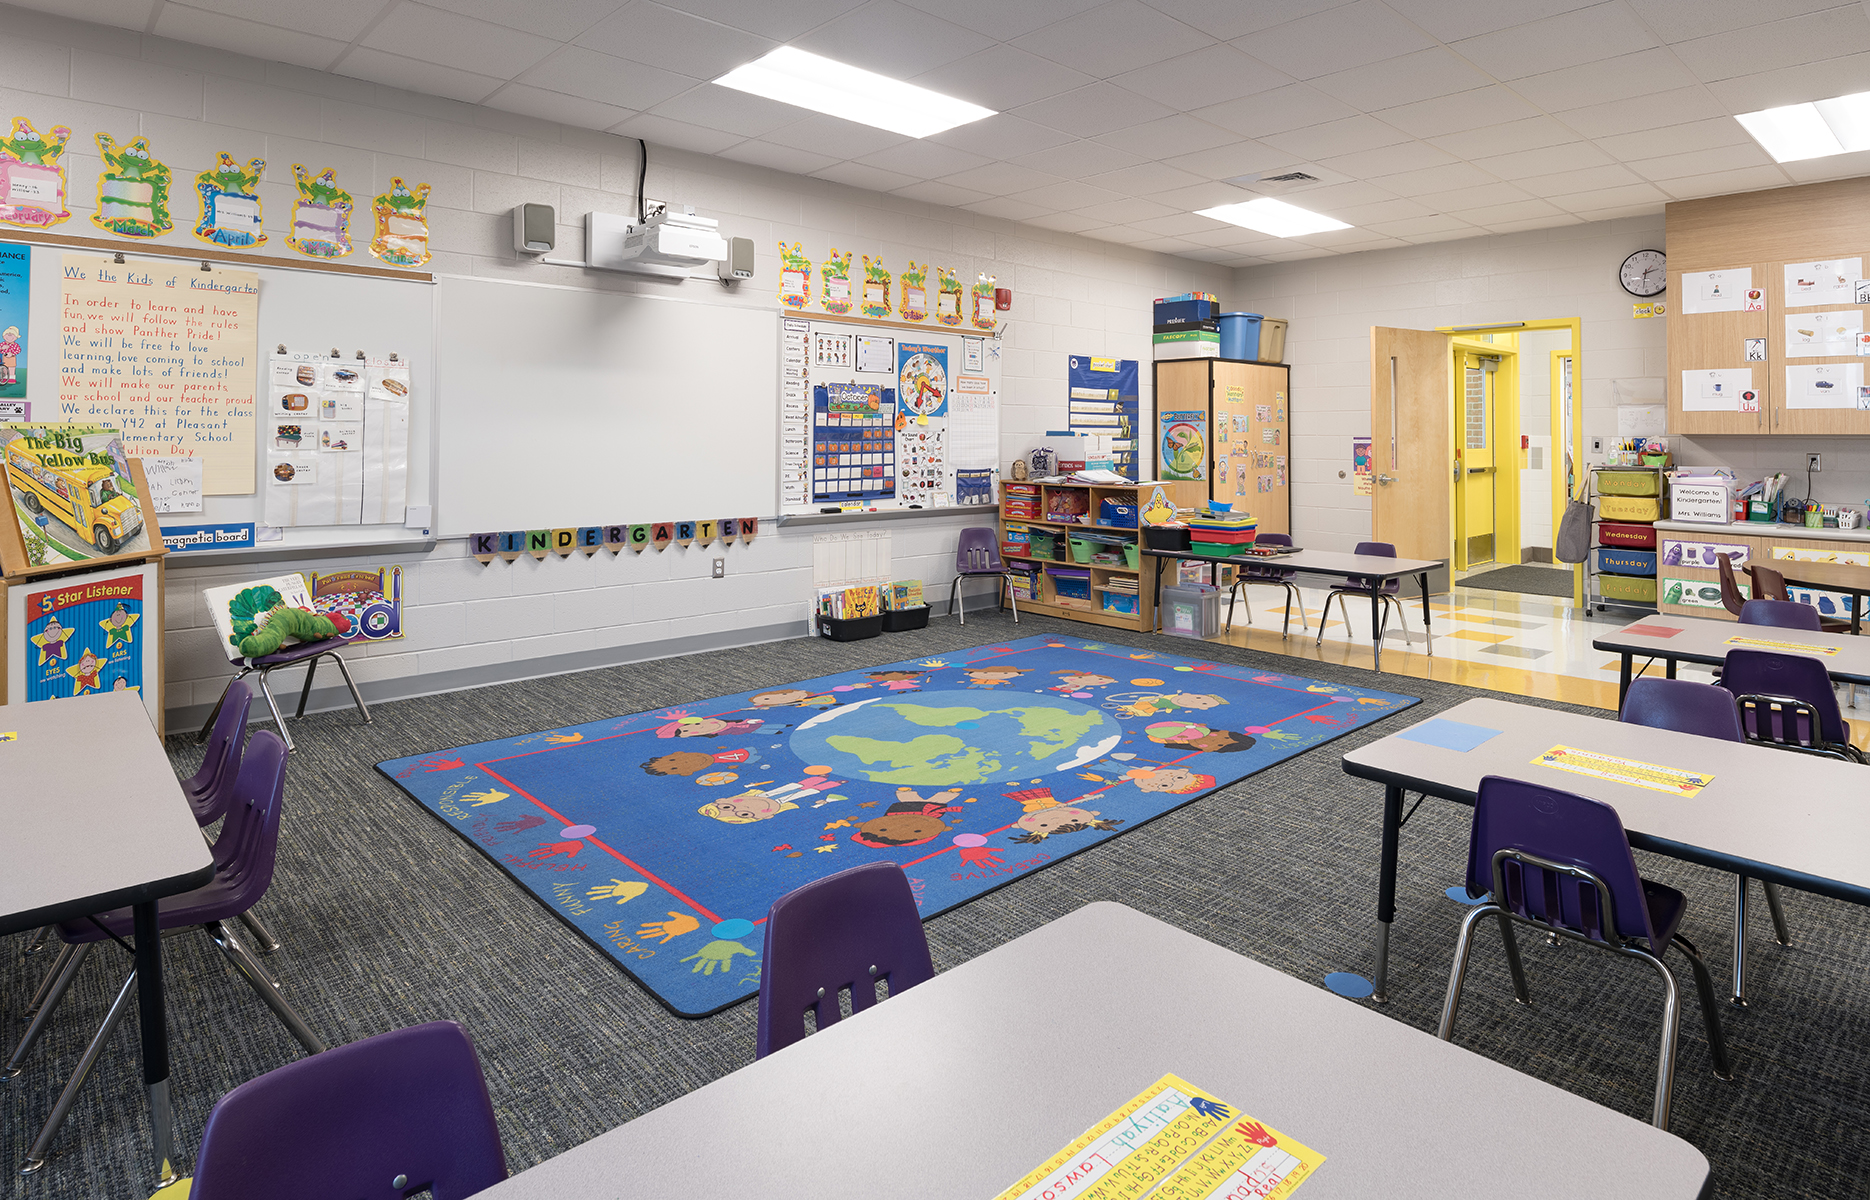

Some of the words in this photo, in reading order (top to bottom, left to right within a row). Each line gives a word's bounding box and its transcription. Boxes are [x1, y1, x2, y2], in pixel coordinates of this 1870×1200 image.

[113, 219, 154, 237] March
[213, 229, 250, 246] April
[308, 242, 333, 258] May
[385, 250, 413, 264] June
[65, 266, 86, 279] We
[98, 269, 117, 282] the
[127, 273, 153, 285] Kids
[166, 276, 177, 286] of
[190, 278, 258, 294] Kindergarten
[65, 293, 79, 305] In
[87, 297, 119, 308] order
[130, 299, 141, 310] to
[149, 301, 176, 312] learn
[184, 305, 204, 314] and
[213, 306, 238, 317] have
[788, 296, 803, 309] July
[1748, 302, 1762, 310] Aa
[87, 313, 104, 321] we
[111, 312, 134, 322] will
[143, 313, 177, 325] follow
[185, 317, 202, 327] the
[211, 320, 238, 330] rules
[64, 323, 86, 333] and
[95, 324, 124, 335] show
[134, 325, 178, 338] Panther
[63, 335, 81, 346] We
[90, 337, 112, 347] will
[122, 338, 133, 349] be
[141, 339, 162, 350] free
[170, 341, 180, 351] to
[189, 342, 208, 353] love
[902, 345, 921, 353] Today's
[118, 352, 138, 363] love
[146, 355, 184, 366] coming
[193, 355, 203, 365] to
[211, 357, 244, 367] school
[294, 354, 329, 362] open
[365, 357, 405, 367] closed
[1749, 352, 1762, 360] Kk
[62, 363, 85, 374] and
[92, 364, 121, 375] make
[133, 365, 153, 376] lots
[162, 367, 173, 377] of
[180, 368, 228, 379] friends!
[62, 376, 81, 388] We
[89, 378, 112, 388] will
[121, 379, 150, 389] make
[60, 393, 78, 401] our
[84, 391, 121, 402] school
[130, 392, 150, 402] and
[156, 395, 173, 403] our
[181, 392, 219, 404] teacher
[841, 391, 868, 401] October
[62, 403, 80, 414] We
[89, 404, 135, 415] declare
[144, 405, 167, 416] this
[176, 406, 192, 417] for
[201, 405, 219, 417] the
[228, 407, 253, 417] class
[1742, 403, 1755, 411] Uu
[121, 418, 145, 429] Y42
[155, 419, 167, 429] at
[177, 419, 228, 429] Pleasant
[24, 436, 52, 450] The
[54, 433, 84, 453] Big
[122, 432, 184, 445] lementary
[195, 432, 233, 442] School
[171, 445, 195, 457] Day
[36, 454, 85, 468] Yellow
[89, 452, 115, 466] Bus
[1604, 480, 1646, 488] Monday
[1606, 505, 1649, 515] Tuesday
[163, 532, 212, 548] magnetic
[216, 530, 248, 542] board
[478, 520, 754, 552] KINDERGARTEN
[1605, 531, 1648, 540] Wednesday
[1605, 558, 1648, 568] Thursday
[1606, 584, 1648, 595] Friday
[42, 596, 52, 612] 5
[57, 591, 83, 606] Star
[86, 586, 133, 599] Listener
[112, 650, 127, 658] EARS
[46, 667, 60, 676] EYES
[500, 853, 588, 872] HELPFUL
[552, 881, 593, 917] FUNNY
[603, 919, 656, 960] CARING
[1111, 1094, 1189, 1151] Aaliyah
[1033, 1152, 1114, 1200] Lawso
